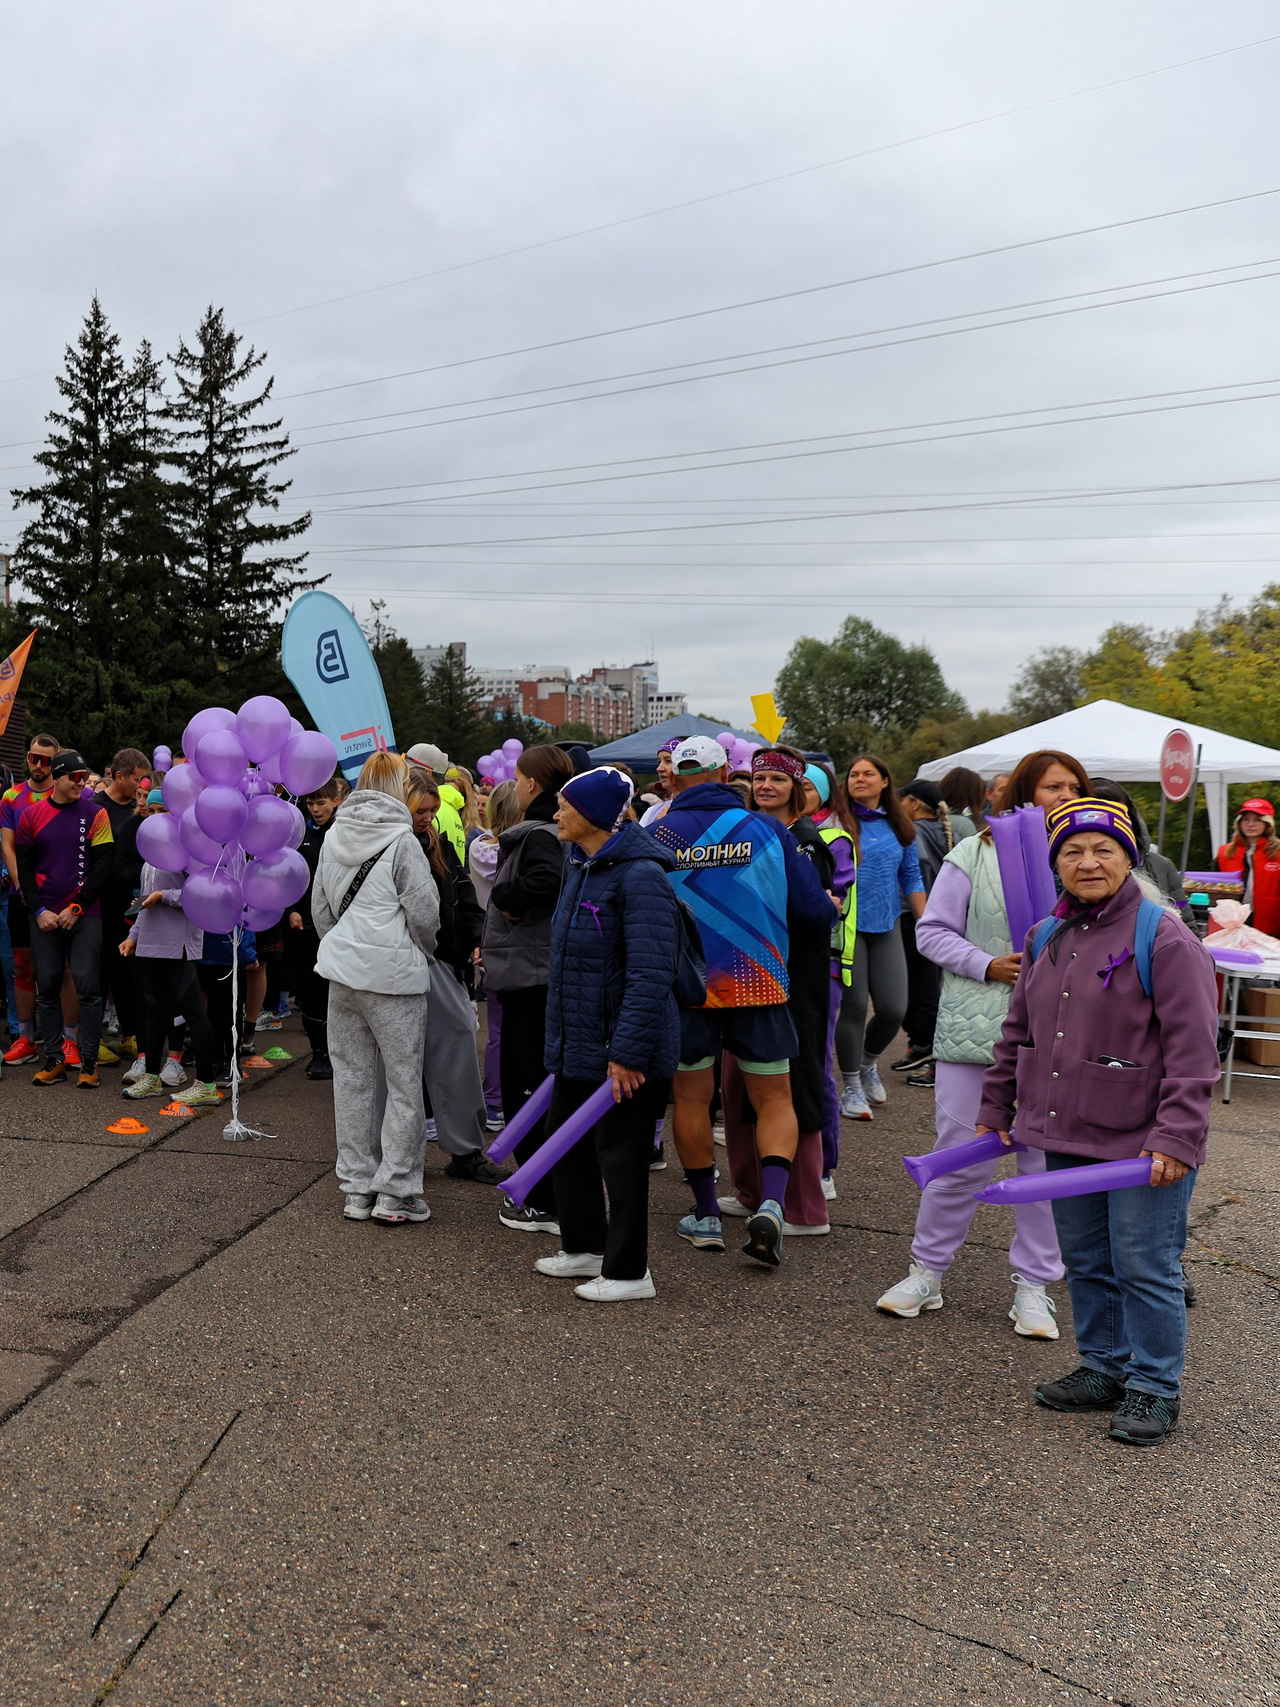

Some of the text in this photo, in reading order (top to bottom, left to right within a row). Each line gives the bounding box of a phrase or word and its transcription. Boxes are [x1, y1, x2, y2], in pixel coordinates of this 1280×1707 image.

[676, 841, 752, 863] МОЛНИЯ
[721, 856, 751, 866] ЖУРНАЛ
[357, 860, 375, 879] KARL
